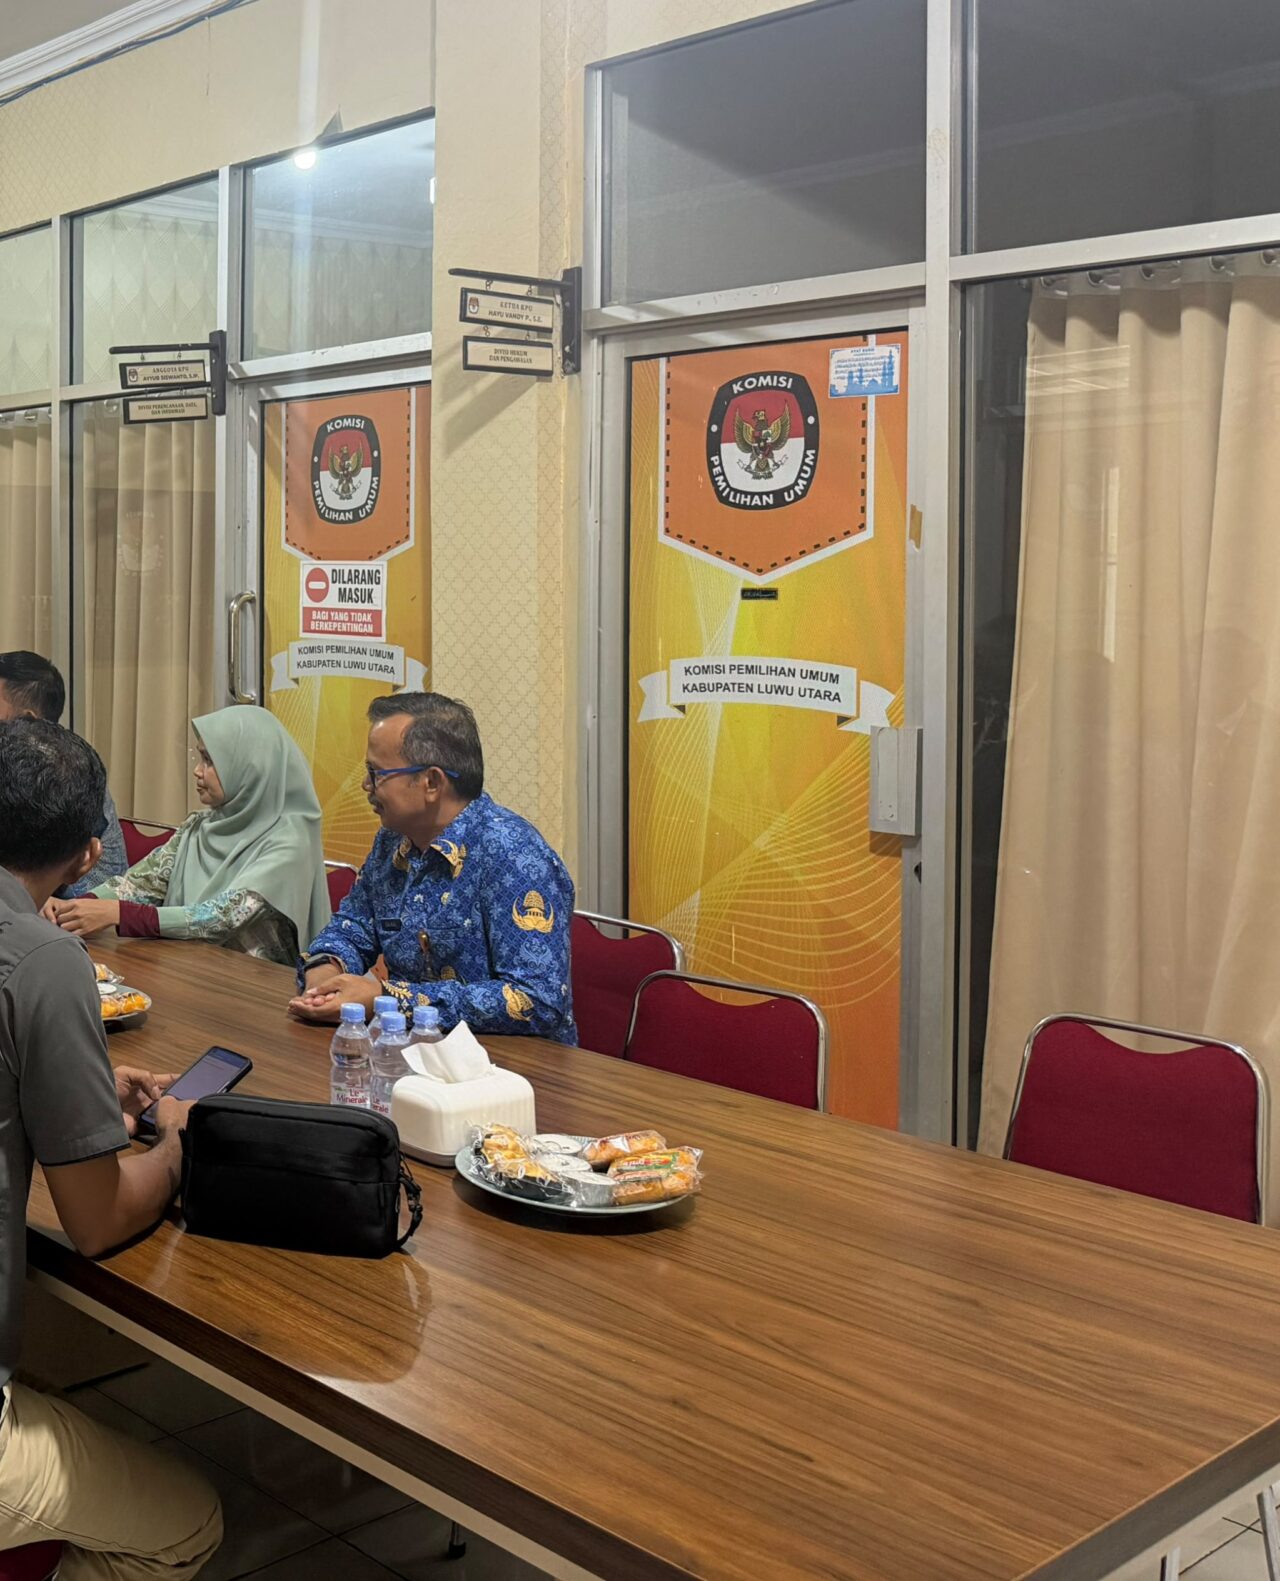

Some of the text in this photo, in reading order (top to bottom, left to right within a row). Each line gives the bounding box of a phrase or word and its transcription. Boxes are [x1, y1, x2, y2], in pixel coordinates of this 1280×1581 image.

[732, 375, 793, 395] KOMISI
[326, 417, 365, 433] KOMISI
[711, 449, 816, 507] PEMILIHAN UMUM
[313, 476, 380, 521] PEMILIHAN UMUM
[331, 568, 381, 586] DILARANG
[338, 586, 374, 604] MASUK
[312, 610, 373, 623] BAGI YANG TIDAK
[310, 621, 374, 634] BERKEPENTINGAN
[298, 645, 394, 660] KOMISI PEMILIHAN UMUM
[296, 659, 395, 675] KABUPATEN LUWU UTARA
[684, 664, 840, 684] KOMISI PEMILIHAN UMUM
[682, 682, 841, 703] KABUPATEN LUWU UTARA
[350, 1089, 359, 1097] Le
